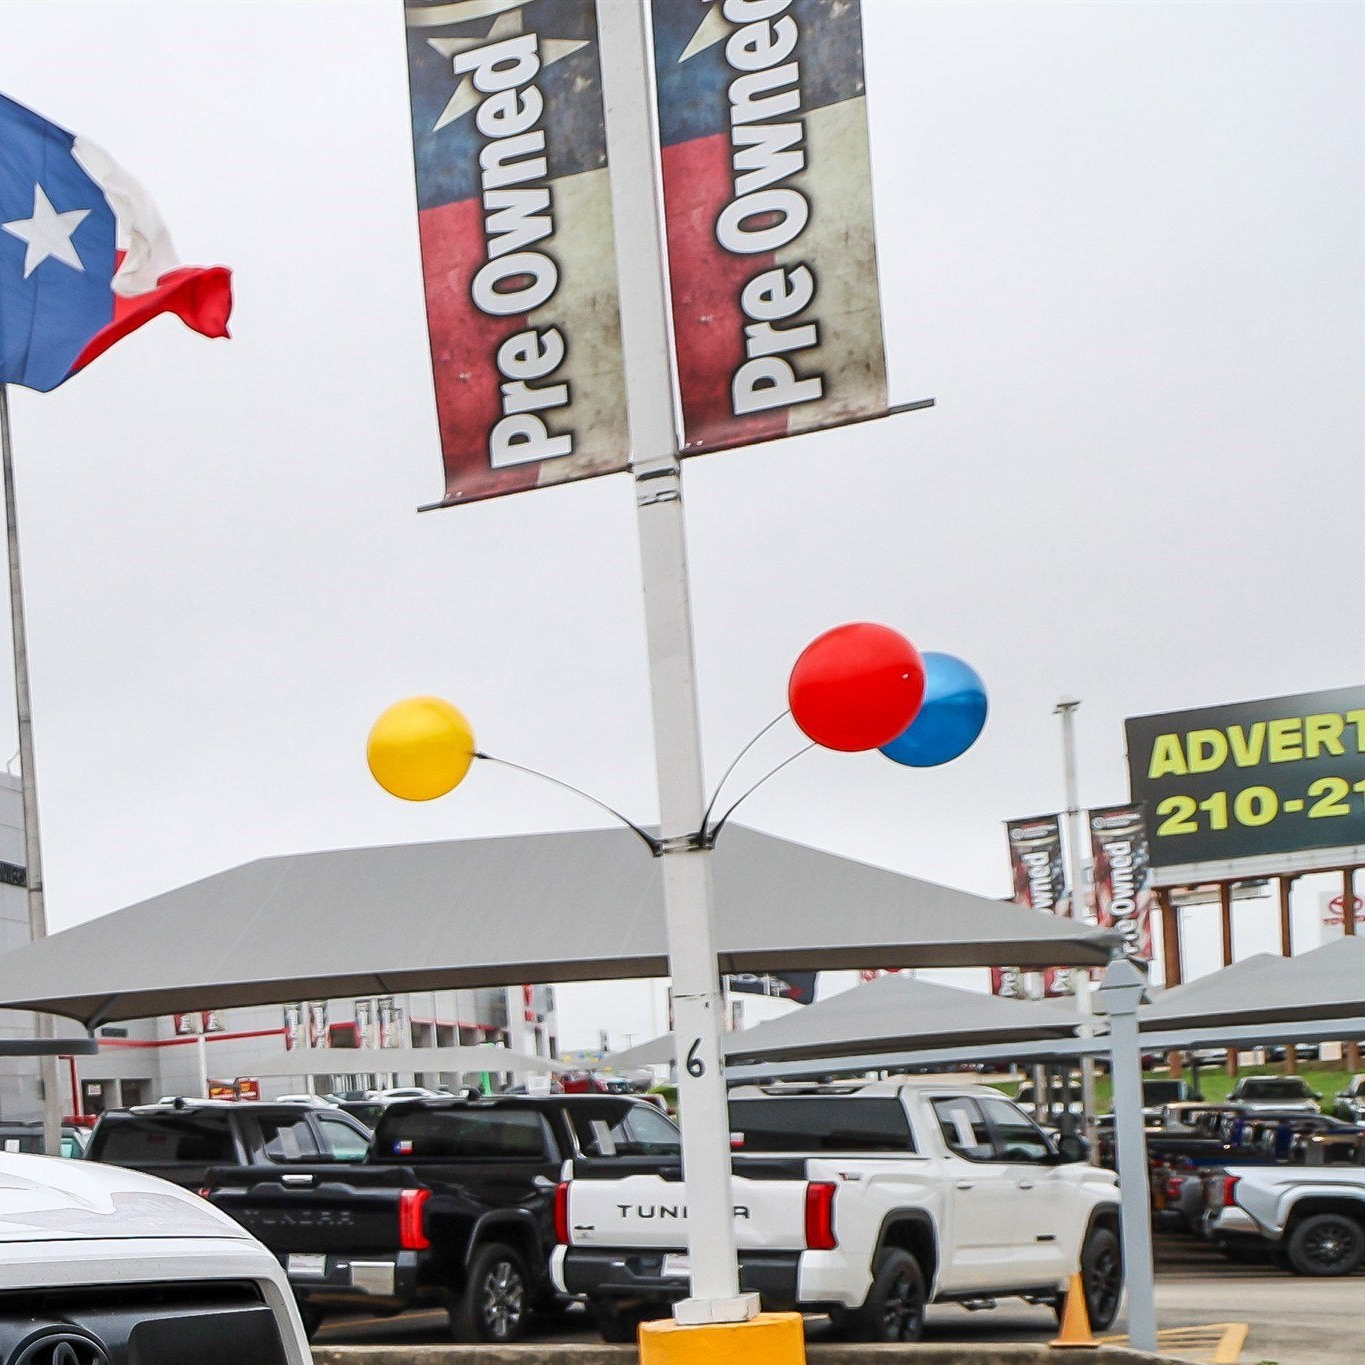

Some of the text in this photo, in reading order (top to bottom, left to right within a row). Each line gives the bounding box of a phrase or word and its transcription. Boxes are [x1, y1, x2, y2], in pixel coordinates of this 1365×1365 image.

[453, 32, 573, 469] Pre Owned
[732, 265, 823, 416] Pre
[1020, 851, 1055, 914] wned
[1103, 841, 1136, 917] Owned
[686, 1037, 706, 1078] 6
[617, 1204, 750, 1220] TUNA
